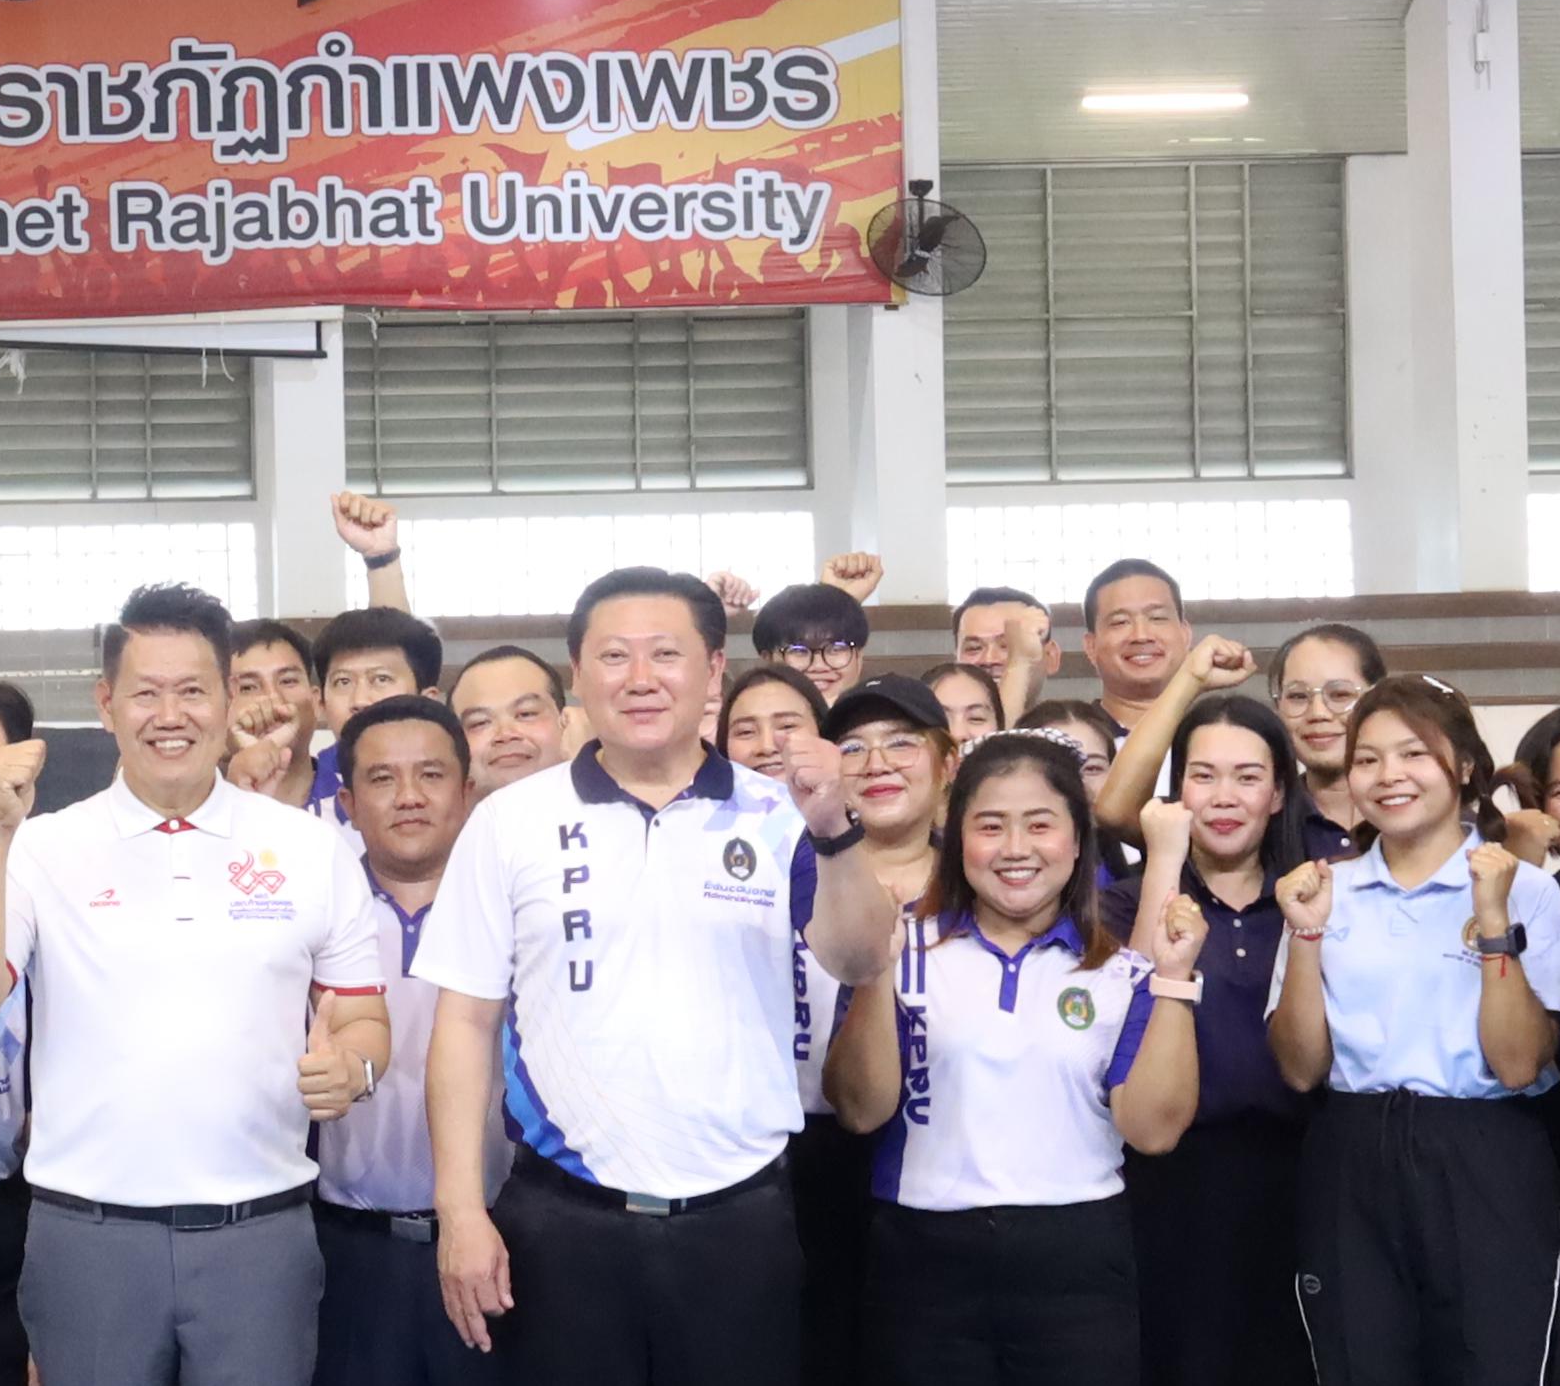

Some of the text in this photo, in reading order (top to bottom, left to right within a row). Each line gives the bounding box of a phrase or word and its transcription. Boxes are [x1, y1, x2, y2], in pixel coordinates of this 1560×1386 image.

[116, 184, 435, 259] Rajabhat
[469, 175, 825, 247] University
[558, 822, 593, 992] KPRU
[906, 1006, 931, 1125] KPRU
